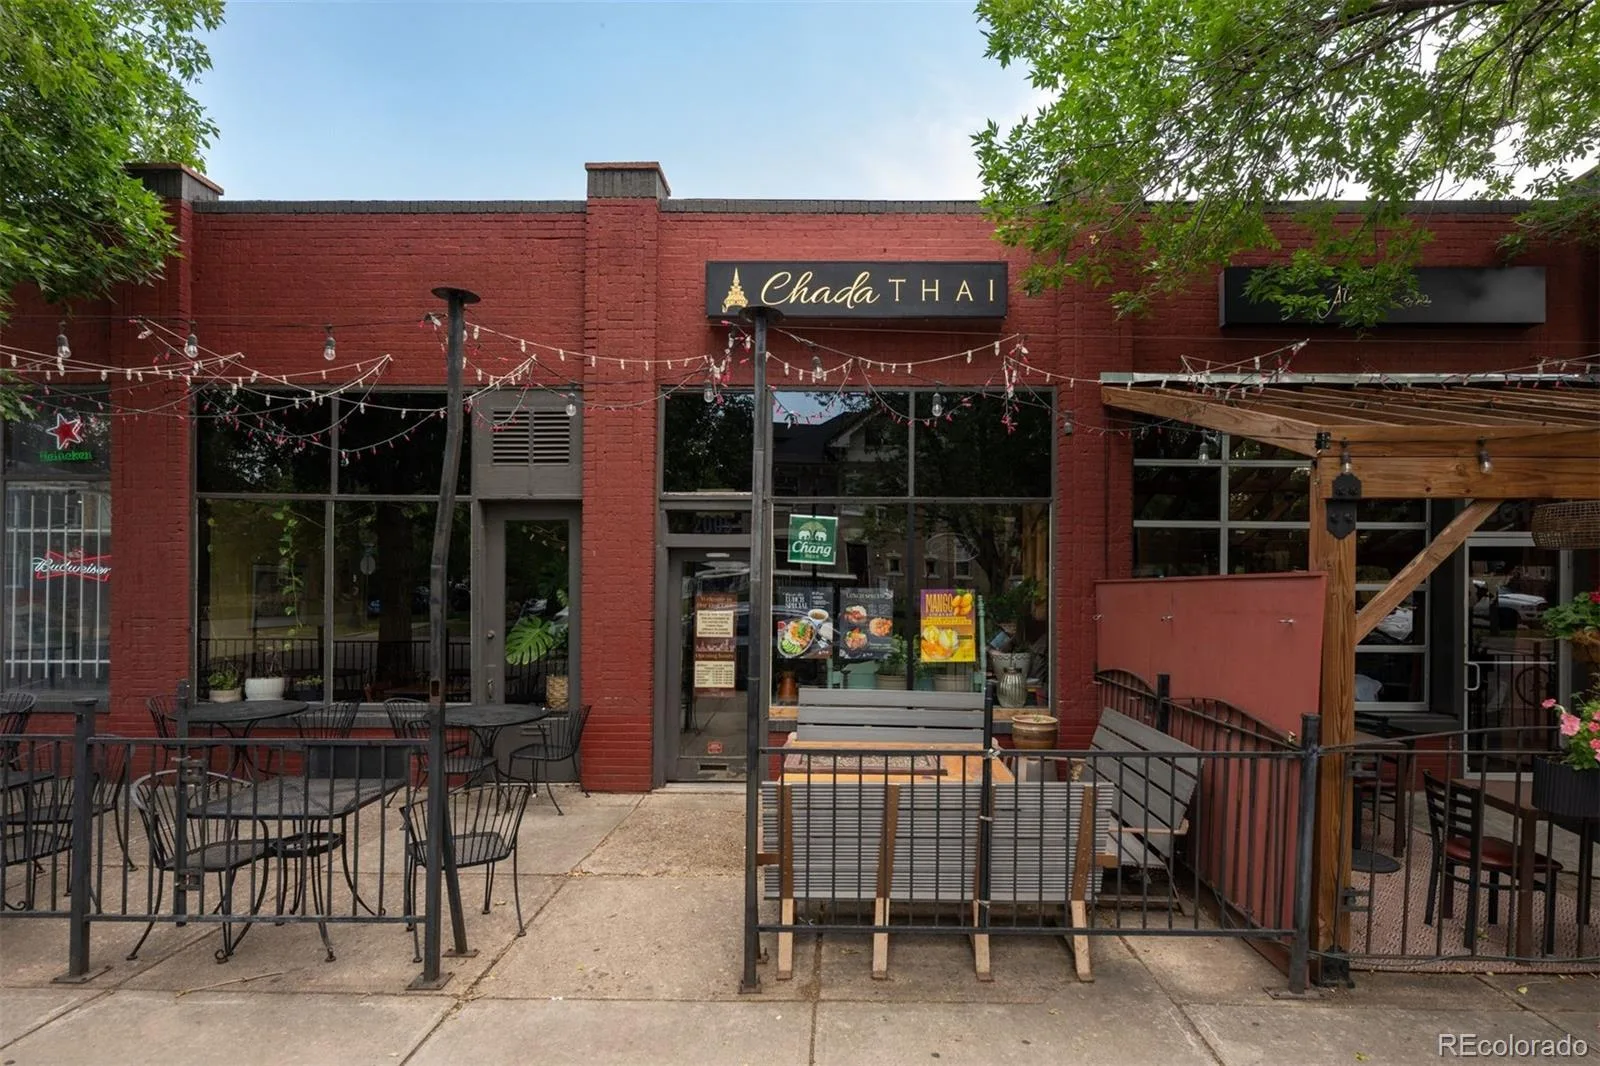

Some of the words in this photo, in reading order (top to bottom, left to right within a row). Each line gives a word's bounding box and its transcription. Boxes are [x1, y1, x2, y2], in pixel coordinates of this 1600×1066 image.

[760, 271, 880, 309] Chada
[888, 278, 995, 302] THAI
[39, 450, 93, 462] Heineken
[791, 540, 832, 558] Chang
[32, 556, 112, 575] Budweiser
[925, 593, 953, 614] MANGO
